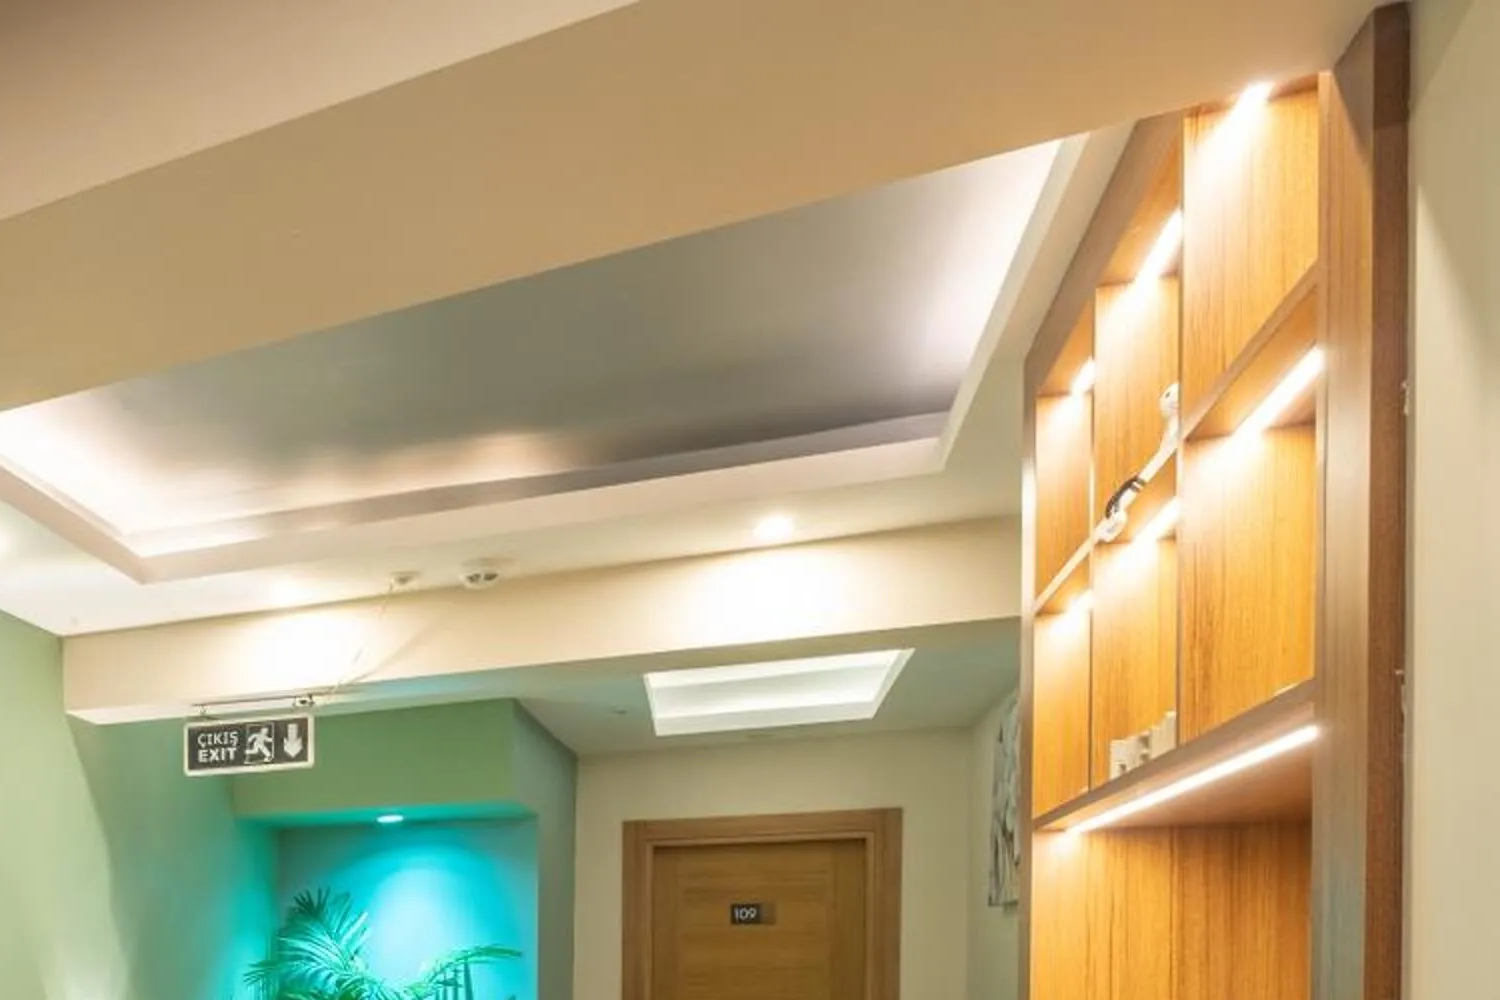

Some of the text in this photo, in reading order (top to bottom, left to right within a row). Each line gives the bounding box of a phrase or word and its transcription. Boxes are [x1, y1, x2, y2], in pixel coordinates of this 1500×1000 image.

[197, 730, 239, 749] ÇIKIŞ
[197, 747, 237, 763] EXIT
[734, 906, 758, 921] 109
